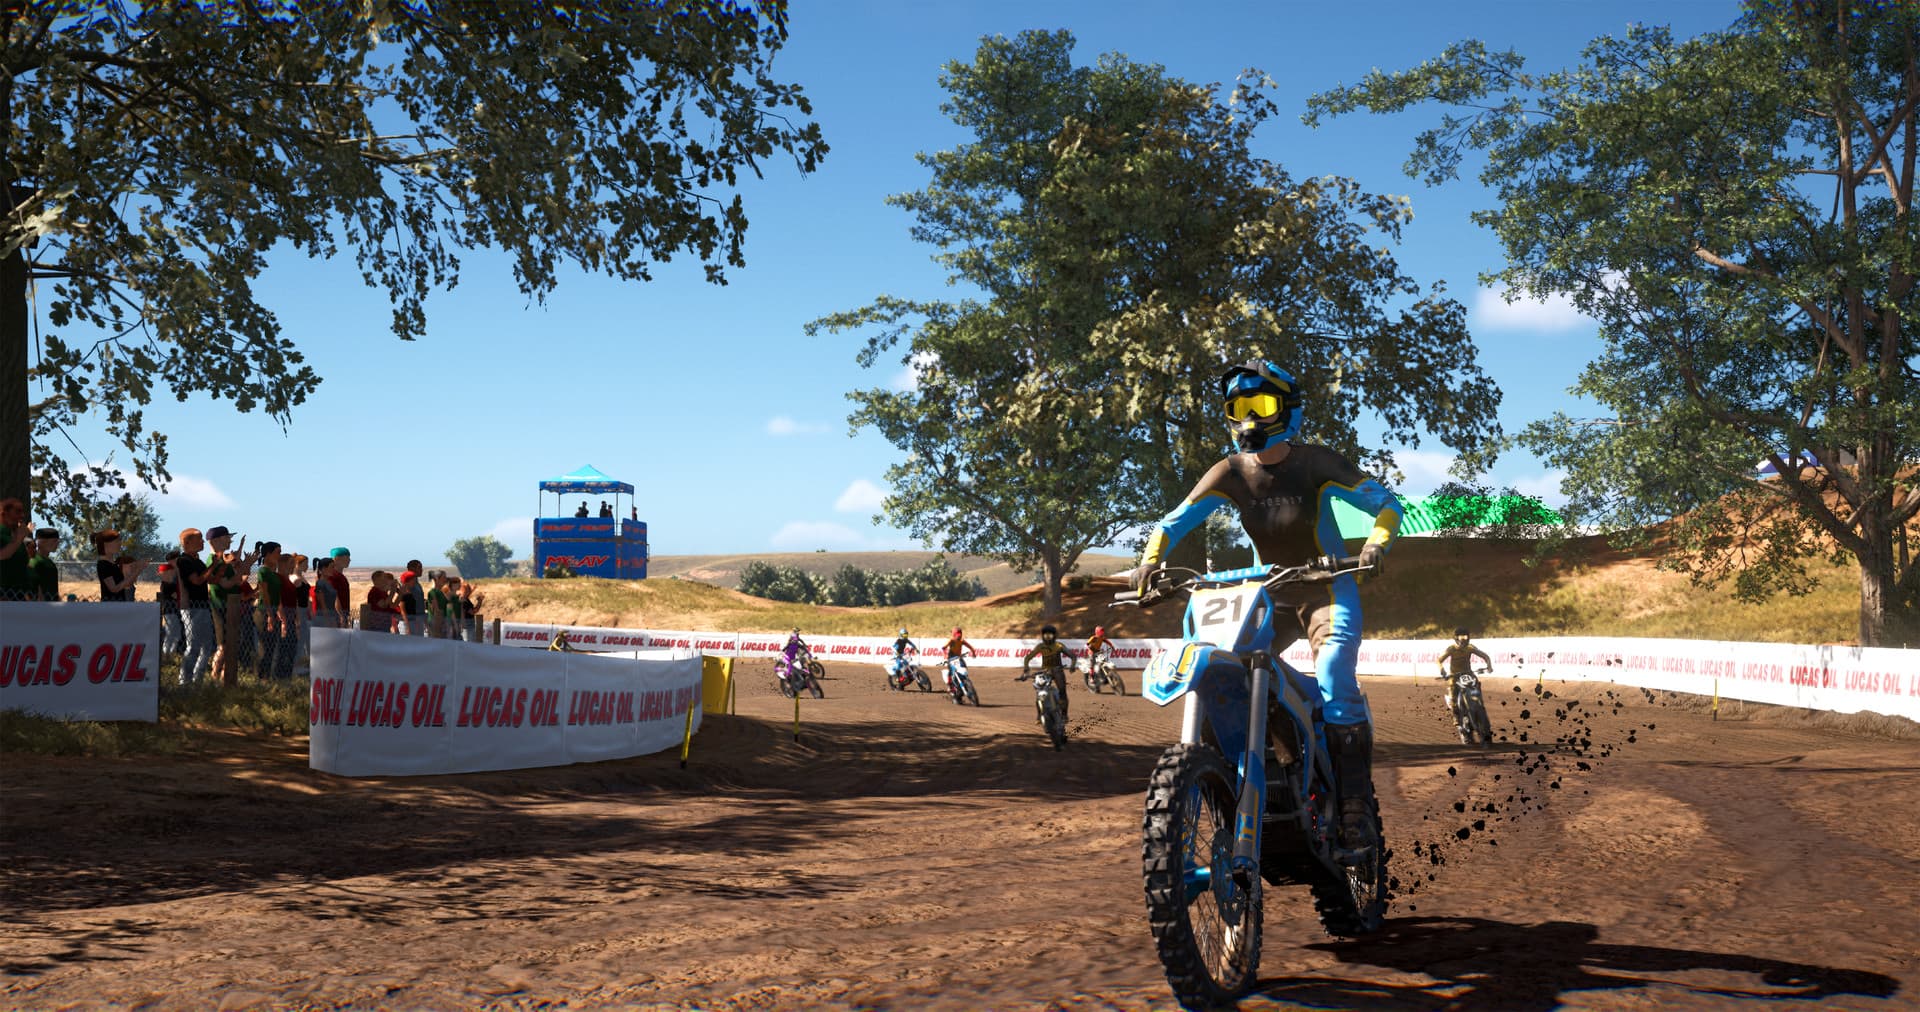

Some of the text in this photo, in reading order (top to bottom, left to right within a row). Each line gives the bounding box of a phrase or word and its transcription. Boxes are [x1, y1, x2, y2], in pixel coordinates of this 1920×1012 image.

[1201, 595, 1243, 626] 21
[505, 631, 549, 641] LUCAS OIL
[602, 636, 644, 646] LUCAS OIL
[648, 638, 690, 648] LUCAS OIL
[695, 640, 735, 650] LUCAS OIL
[740, 642, 781, 652] LUCAS OIL
[813, 644, 826, 653] OIL
[831, 645, 871, 655] LUCAS OIL
[997, 649, 1010, 657] OIL
[1110, 649, 1136, 658] LUCAS
[1139, 649, 1151, 658] OIL
[0, 643, 147, 687] UCAS OIL
[1700, 659, 1736, 678] LUCAS OIL
[1742, 661, 1783, 683] LUCAS OIL
[1790, 665, 1837, 688] LUCAS OIL
[1845, 670, 1880, 692] LUCAS
[1883, 672, 1901, 695] OIL
[346, 681, 410, 728] LUCAS
[411, 683, 446, 727] OIL
[456, 686, 559, 728] LUCAS OIL
[567, 691, 633, 726] LUCAS OIL
